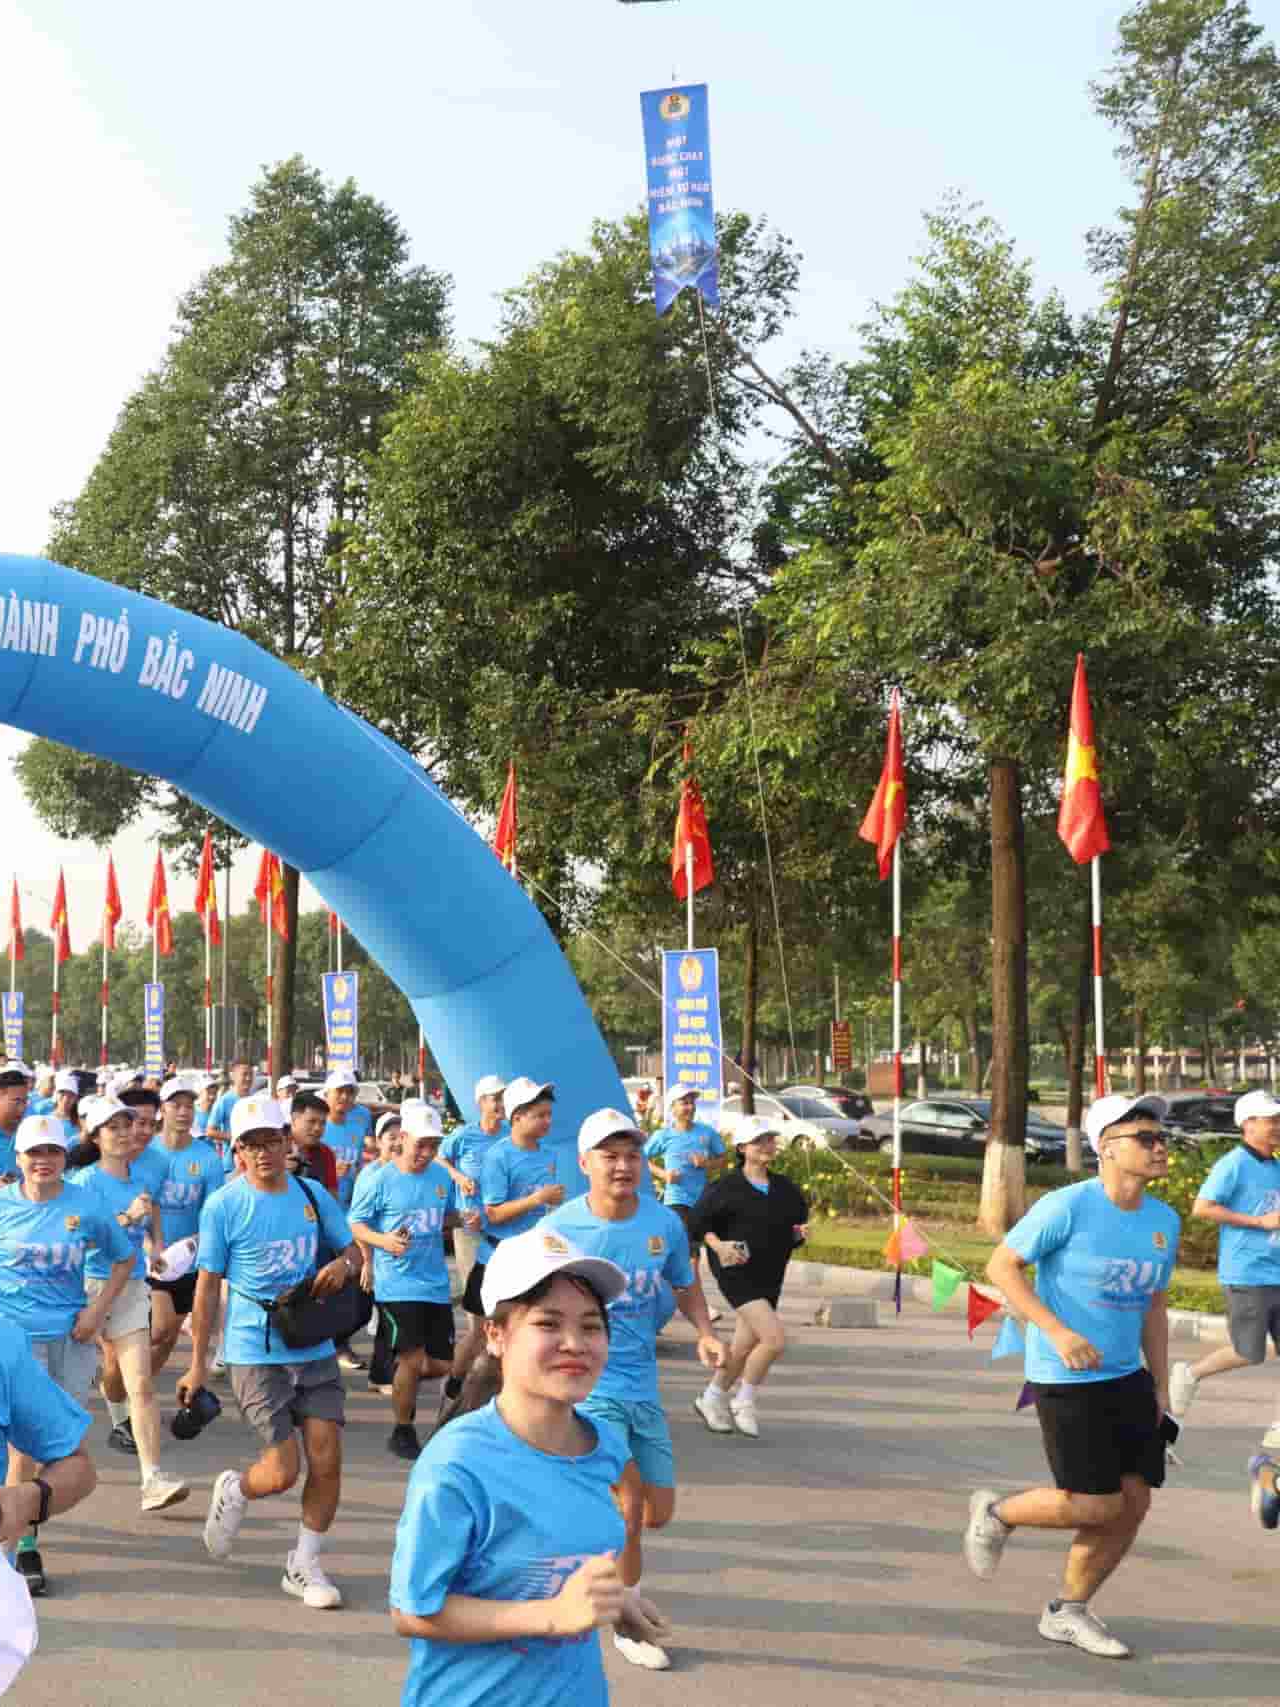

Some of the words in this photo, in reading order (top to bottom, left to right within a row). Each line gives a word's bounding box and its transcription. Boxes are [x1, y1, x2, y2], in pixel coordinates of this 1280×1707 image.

[73, 607, 130, 673] PHỐ
[138, 630, 195, 700] BẮC
[196, 663, 268, 735] NINH
